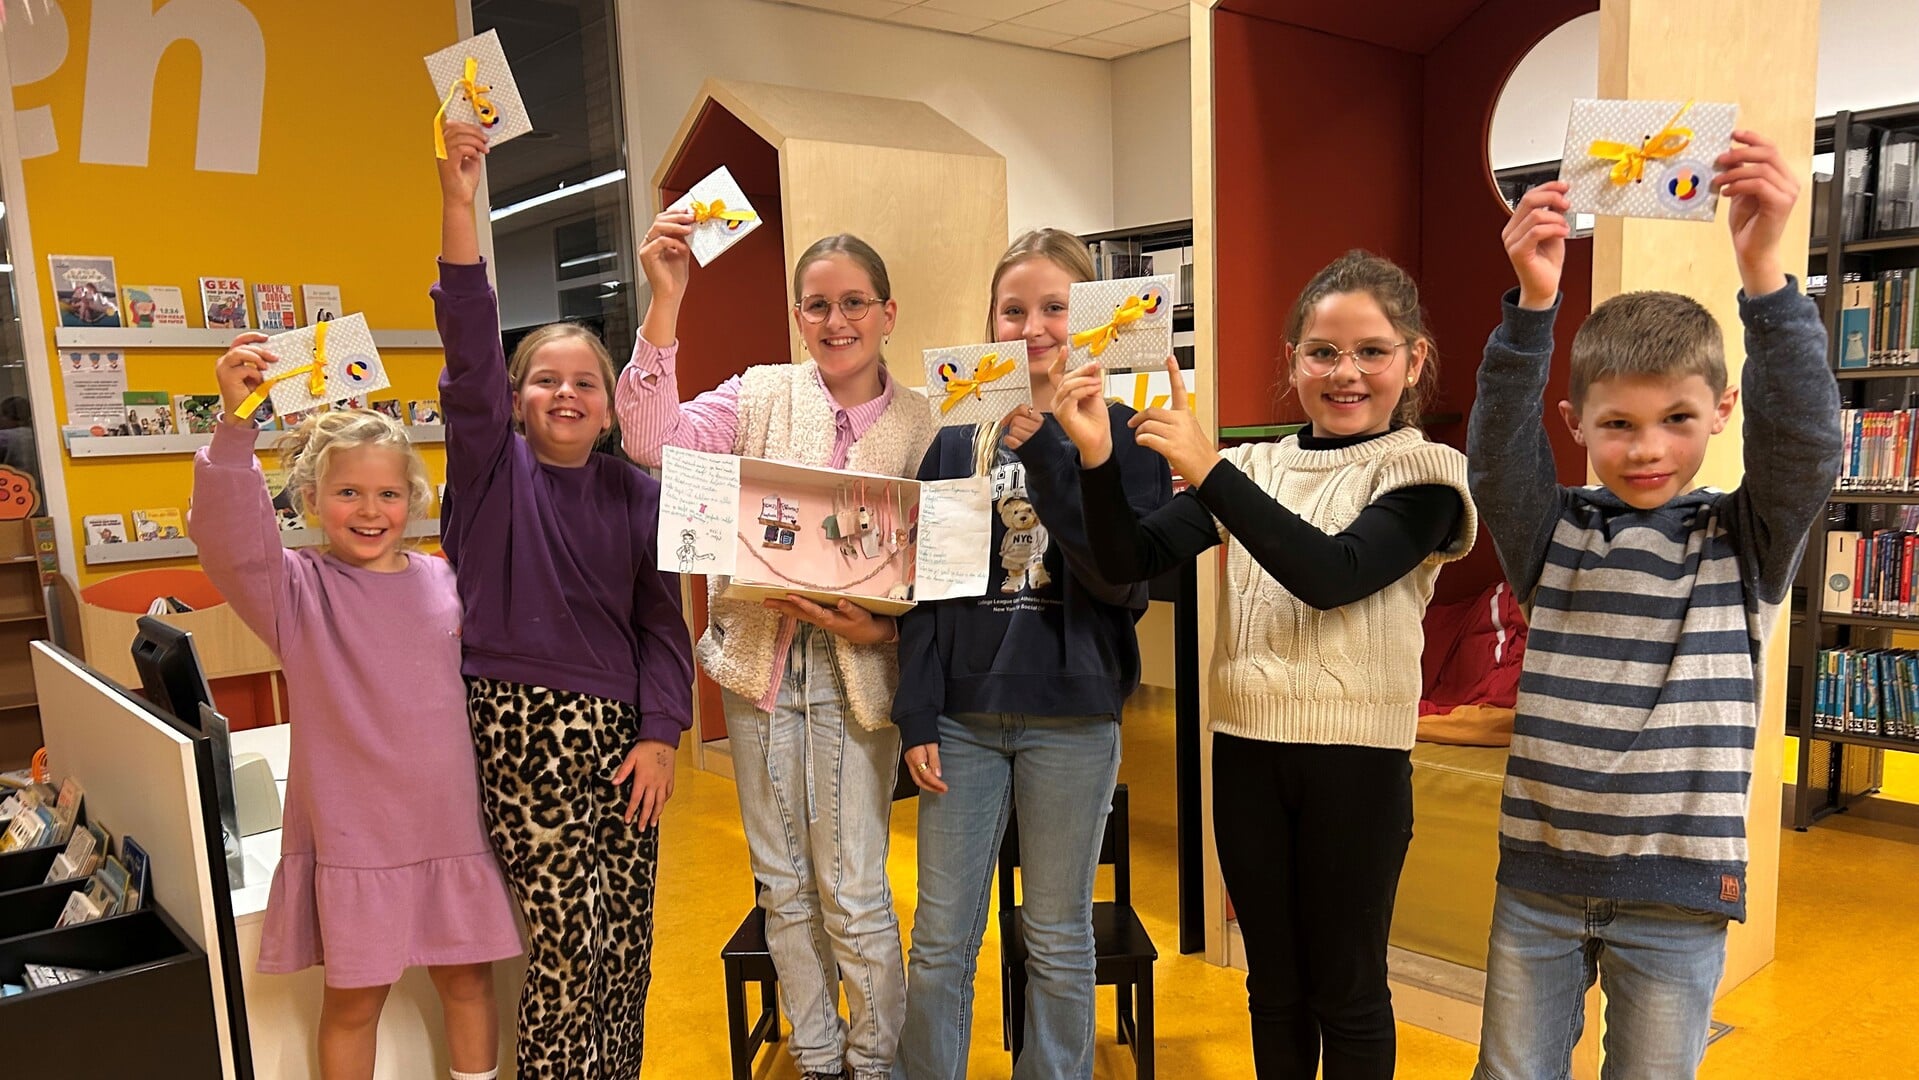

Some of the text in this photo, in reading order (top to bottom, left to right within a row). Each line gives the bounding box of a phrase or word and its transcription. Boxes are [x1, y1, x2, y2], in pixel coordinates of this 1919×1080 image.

[205, 280, 240, 290] GEK
[257, 283, 284, 293] ANDERE
[265, 293, 293, 303] OUDERS
[1853, 285, 1860, 307] j
[262, 301, 281, 311] DOEN
[1013, 534, 1033, 544] NYC
